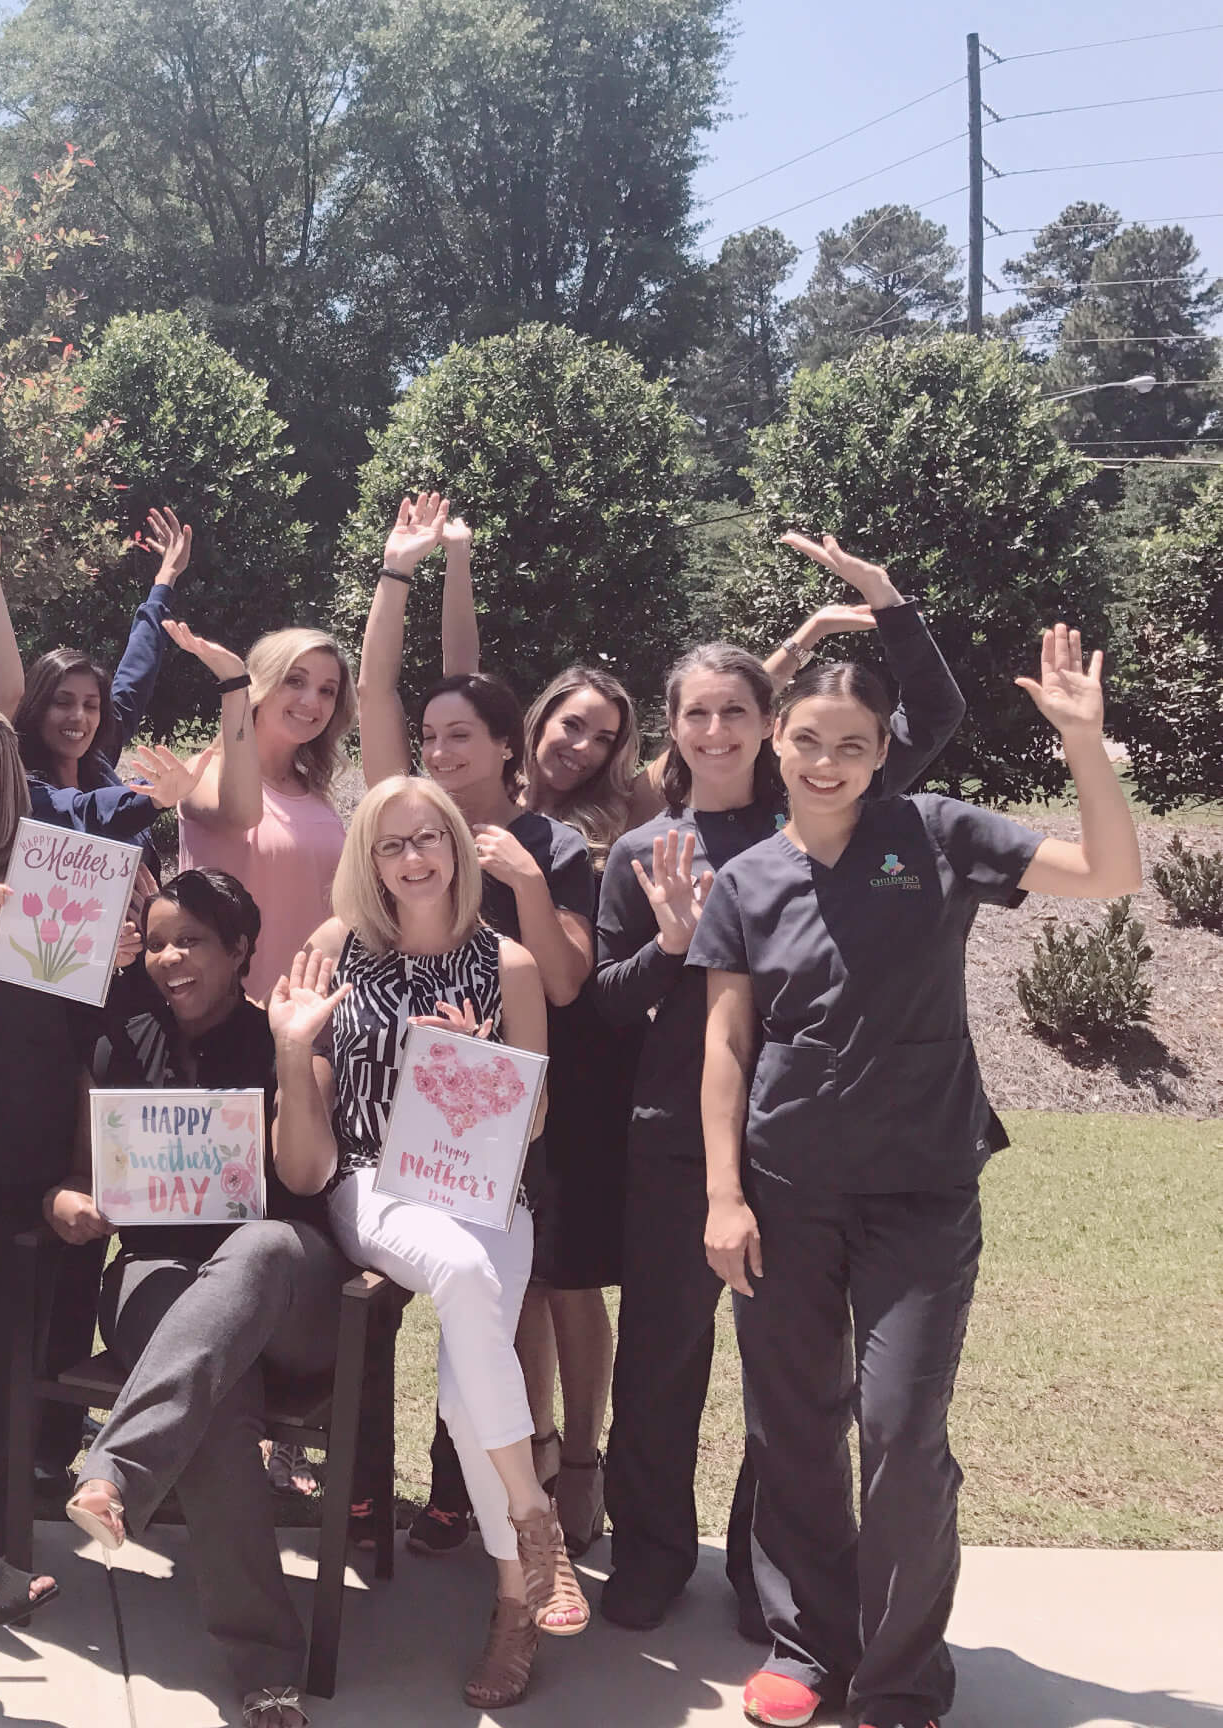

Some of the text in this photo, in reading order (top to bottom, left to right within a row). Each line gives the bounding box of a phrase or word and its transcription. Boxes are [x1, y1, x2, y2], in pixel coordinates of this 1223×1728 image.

[20, 835, 51, 851] HAPPY
[24, 837, 132, 881] Mother's
[71, 871, 98, 890] DAY
[142, 1105, 213, 1135] HAPPY
[130, 1137, 222, 1175] mother's
[148, 1175, 210, 1216] DAY
[399, 1152, 497, 1201] Mother's
